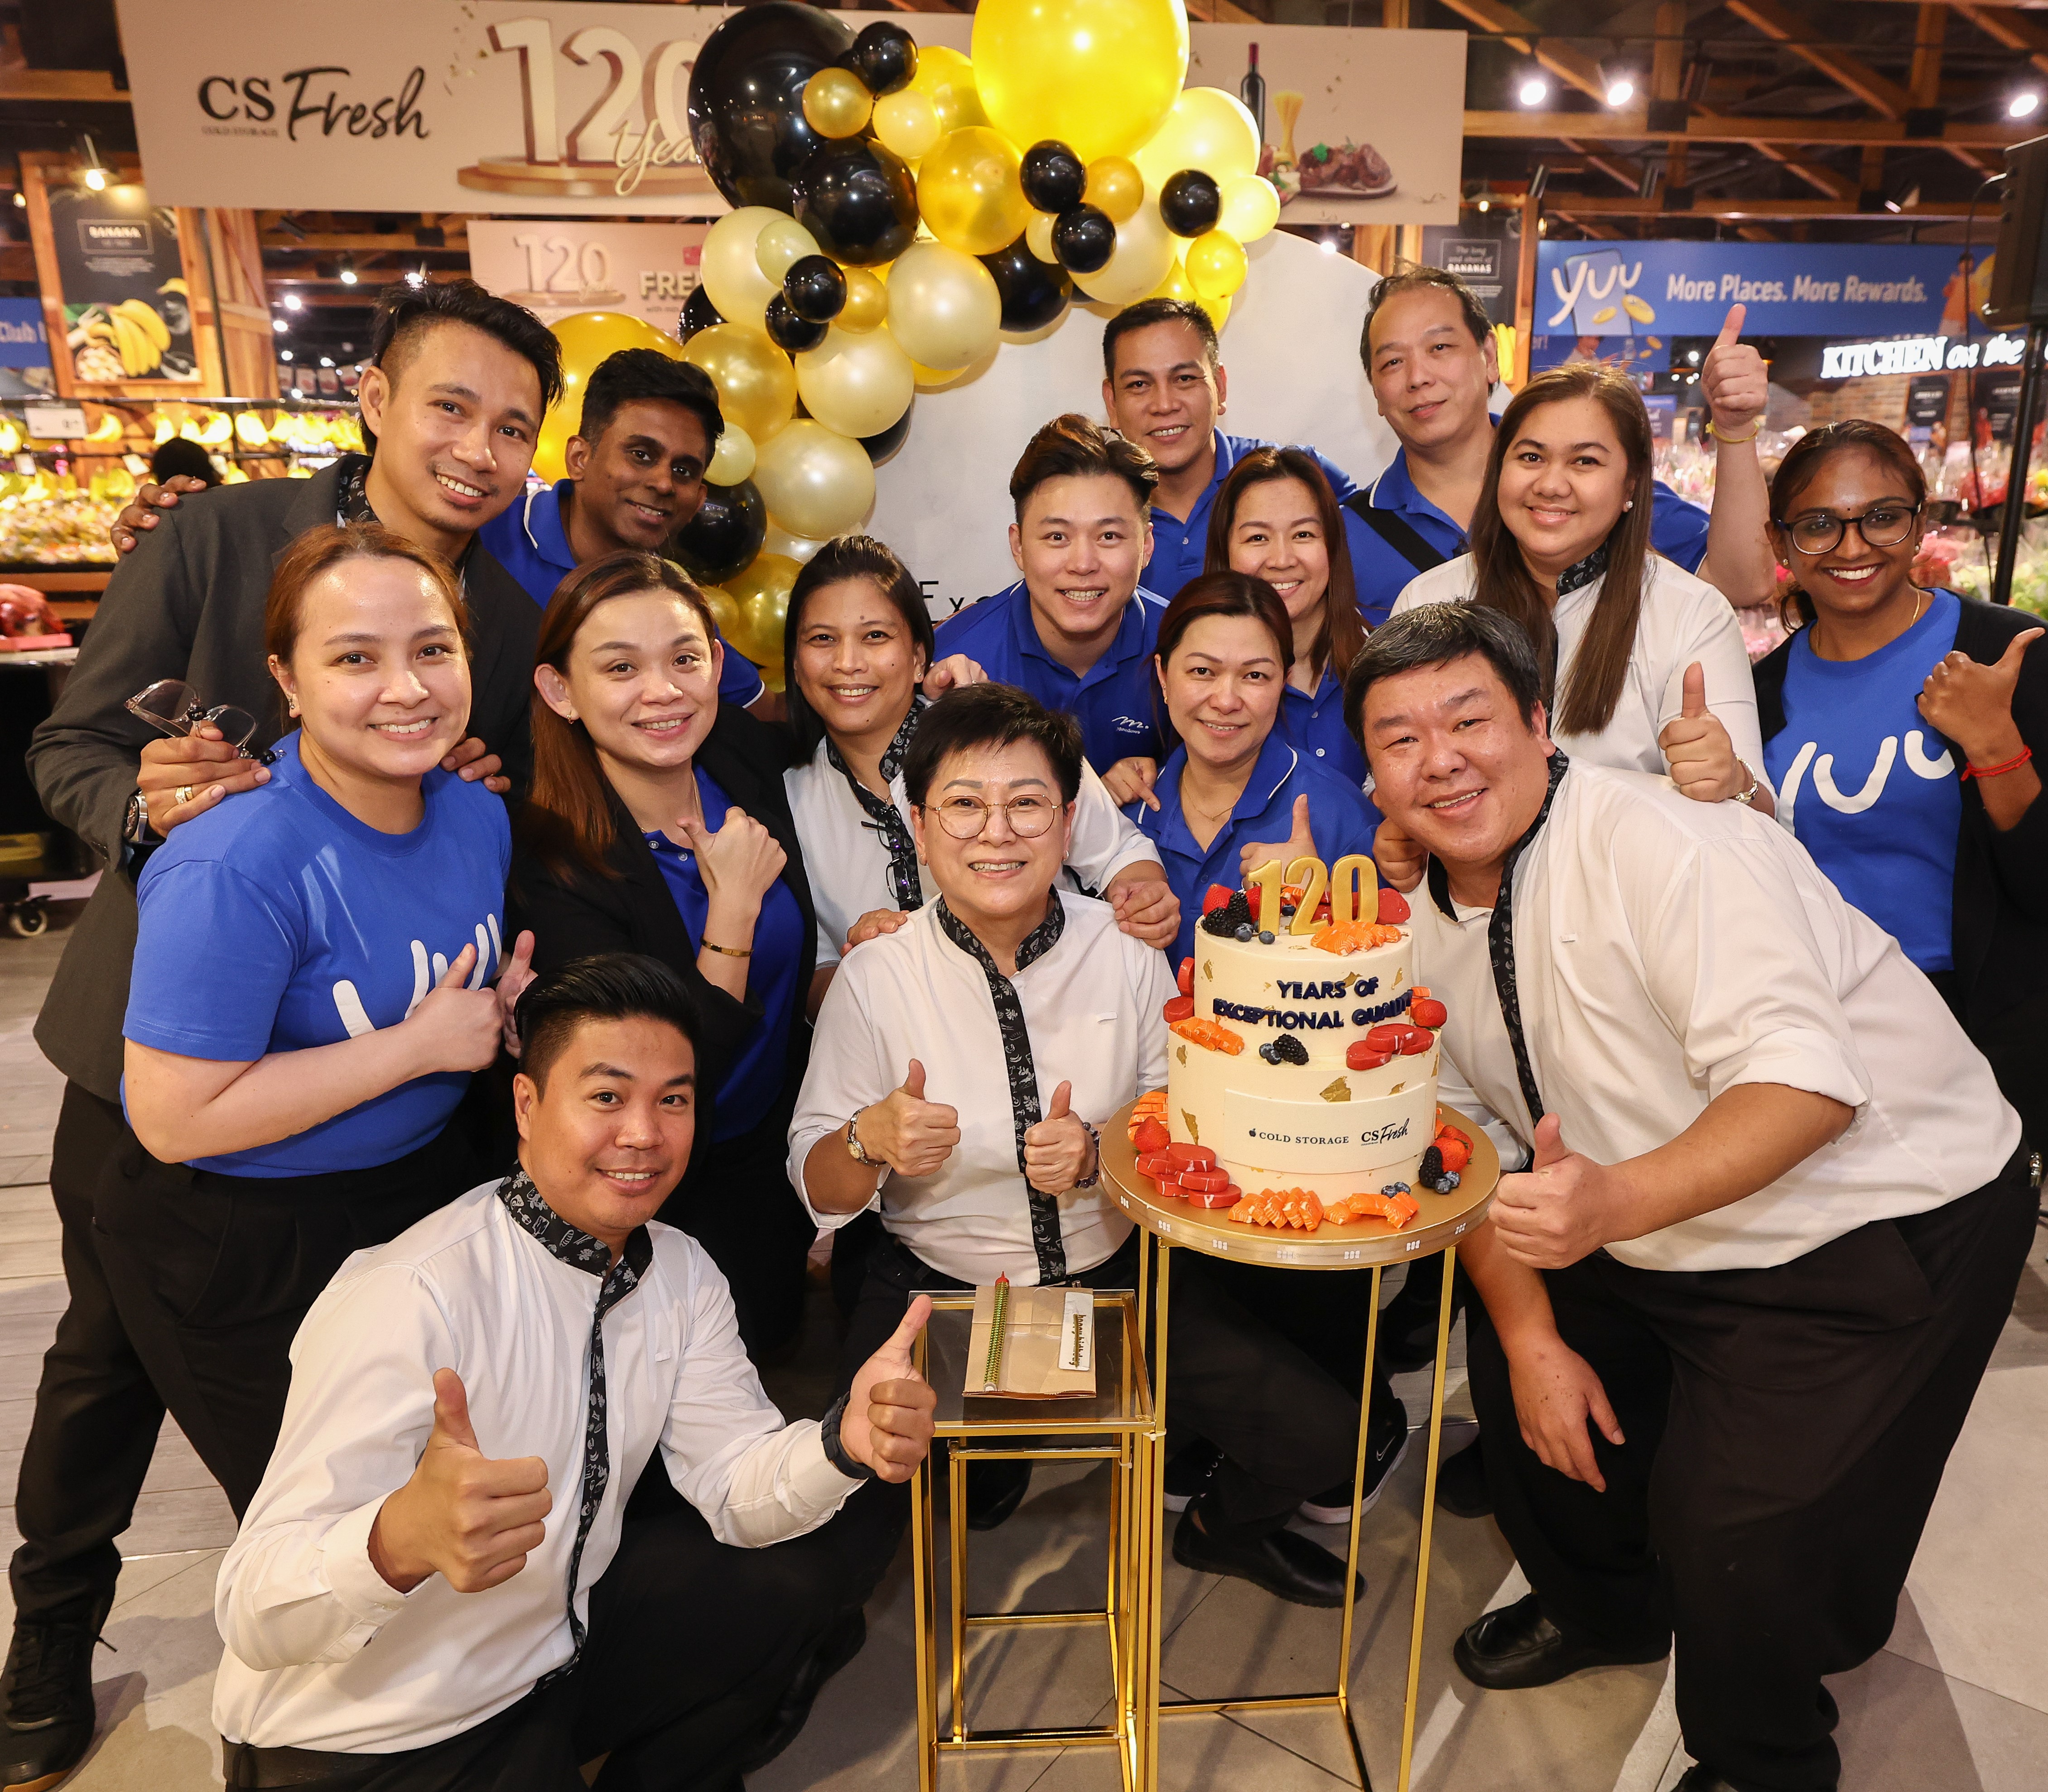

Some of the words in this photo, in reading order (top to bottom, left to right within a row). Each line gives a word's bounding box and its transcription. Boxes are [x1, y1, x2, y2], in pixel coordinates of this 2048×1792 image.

[198, 76, 275, 121] CS
[283, 66, 429, 142] Fresh
[486, 16, 701, 166] 120
[609, 118, 698, 196] Yea
[513, 234, 608, 293] 120
[639, 270, 702, 300] FRE
[1447, 263, 1492, 274] BANANAS
[1547, 261, 1643, 327] yuu
[1666, 273, 1717, 302] More
[1719, 274, 1788, 302] Places.
[1792, 275, 1840, 302] More
[1843, 275, 1928, 303] Rewards.
[1820, 336, 1947, 379] KITCHEN
[1946, 343, 1980, 369] on
[1983, 333, 2026, 366] the
[919, 580, 991, 624] Ex
[1248, 854, 1379, 936] 120
[1277, 980, 1346, 1000] YEARS
[1354, 977, 1378, 997] OF
[1213, 998, 1344, 1030] EXCEPTIONAL
[1259, 1132, 1291, 1143] COLD
[1296, 1136, 1349, 1144] STORAGE
[1361, 1130, 1379, 1142] CS
[1380, 1118, 1410, 1144] Fresh
